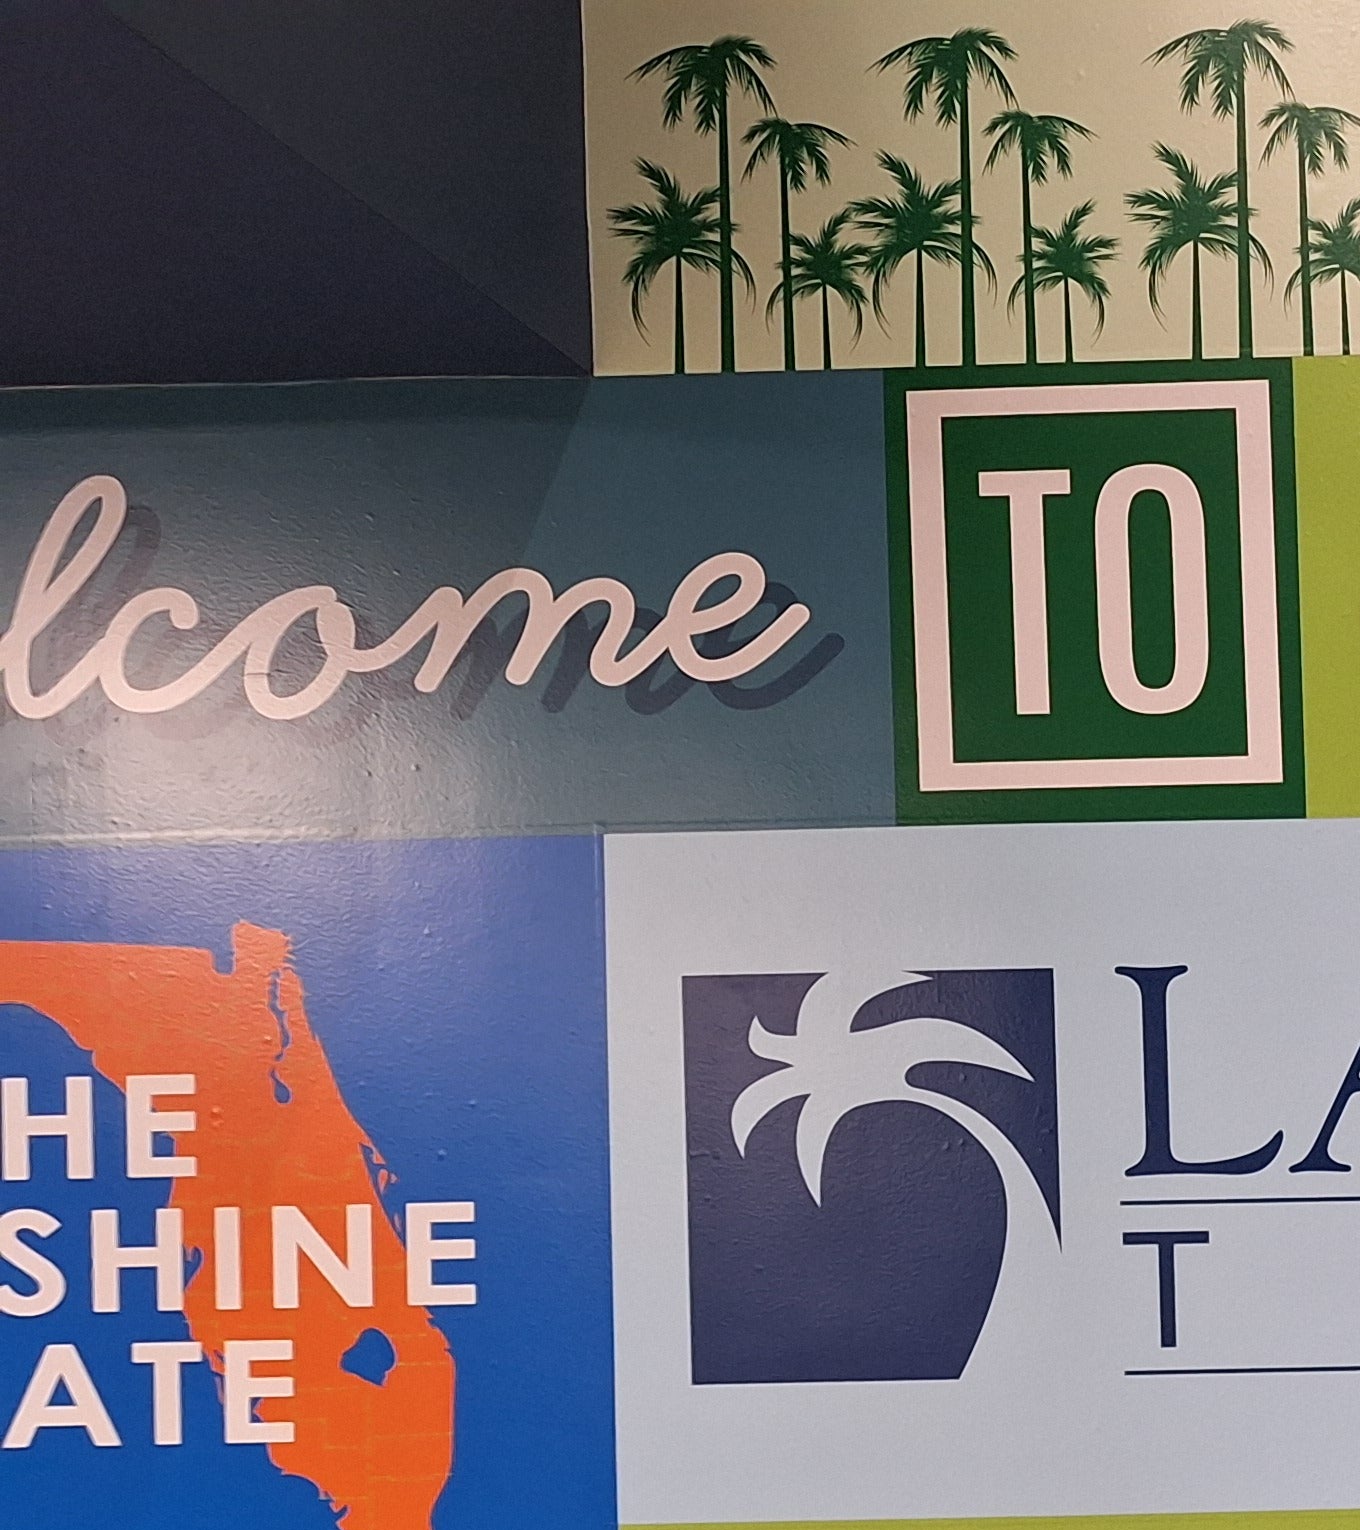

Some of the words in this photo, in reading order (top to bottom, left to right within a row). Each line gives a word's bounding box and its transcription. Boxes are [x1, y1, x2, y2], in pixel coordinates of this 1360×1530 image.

[977, 462, 1210, 716] TO
[0, 1074, 198, 1181] HE
[0, 1201, 477, 1317] SHINE
[2, 1339, 295, 1449] ATE
